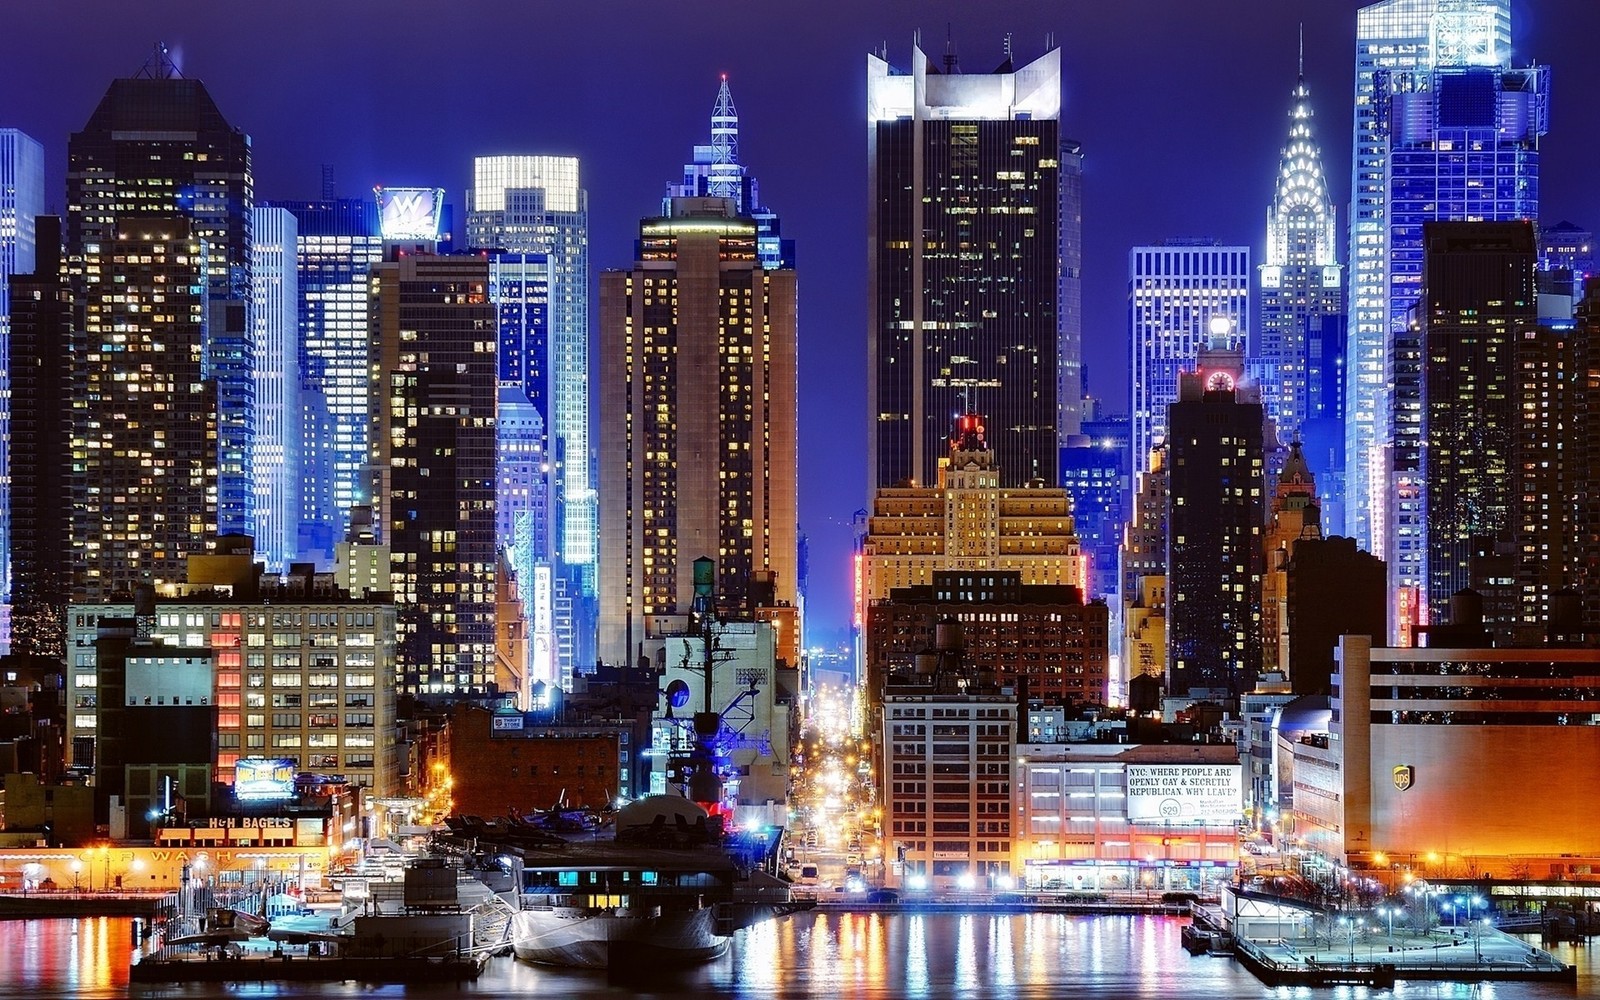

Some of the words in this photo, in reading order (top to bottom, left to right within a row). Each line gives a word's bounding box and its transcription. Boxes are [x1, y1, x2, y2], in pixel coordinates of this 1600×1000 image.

[1129, 768, 1148, 777] NYC:
[1150, 768, 1180, 777] WHERE
[1181, 768, 1213, 777] PEOPLE
[1214, 768, 1232, 777] ARE
[1129, 778, 1160, 787] OPENLY
[1162, 778, 1178, 787] GAY
[1180, 778, 1188, 787] &
[1189, 778, 1231, 787] SECRETLY
[1395, 773, 1408, 787] ups
[1130, 788, 1184, 797] REPUBLICAN.
[1186, 788, 1205, 797] WHY
[1207, 788, 1237, 797] LEAVE?
[1162, 806, 1178, 816] $29
[209, 818, 236, 828] H&H
[242, 818, 291, 828] BAGELS
[79, 851, 135, 862] CAR
[151, 851, 233, 861] WASH
